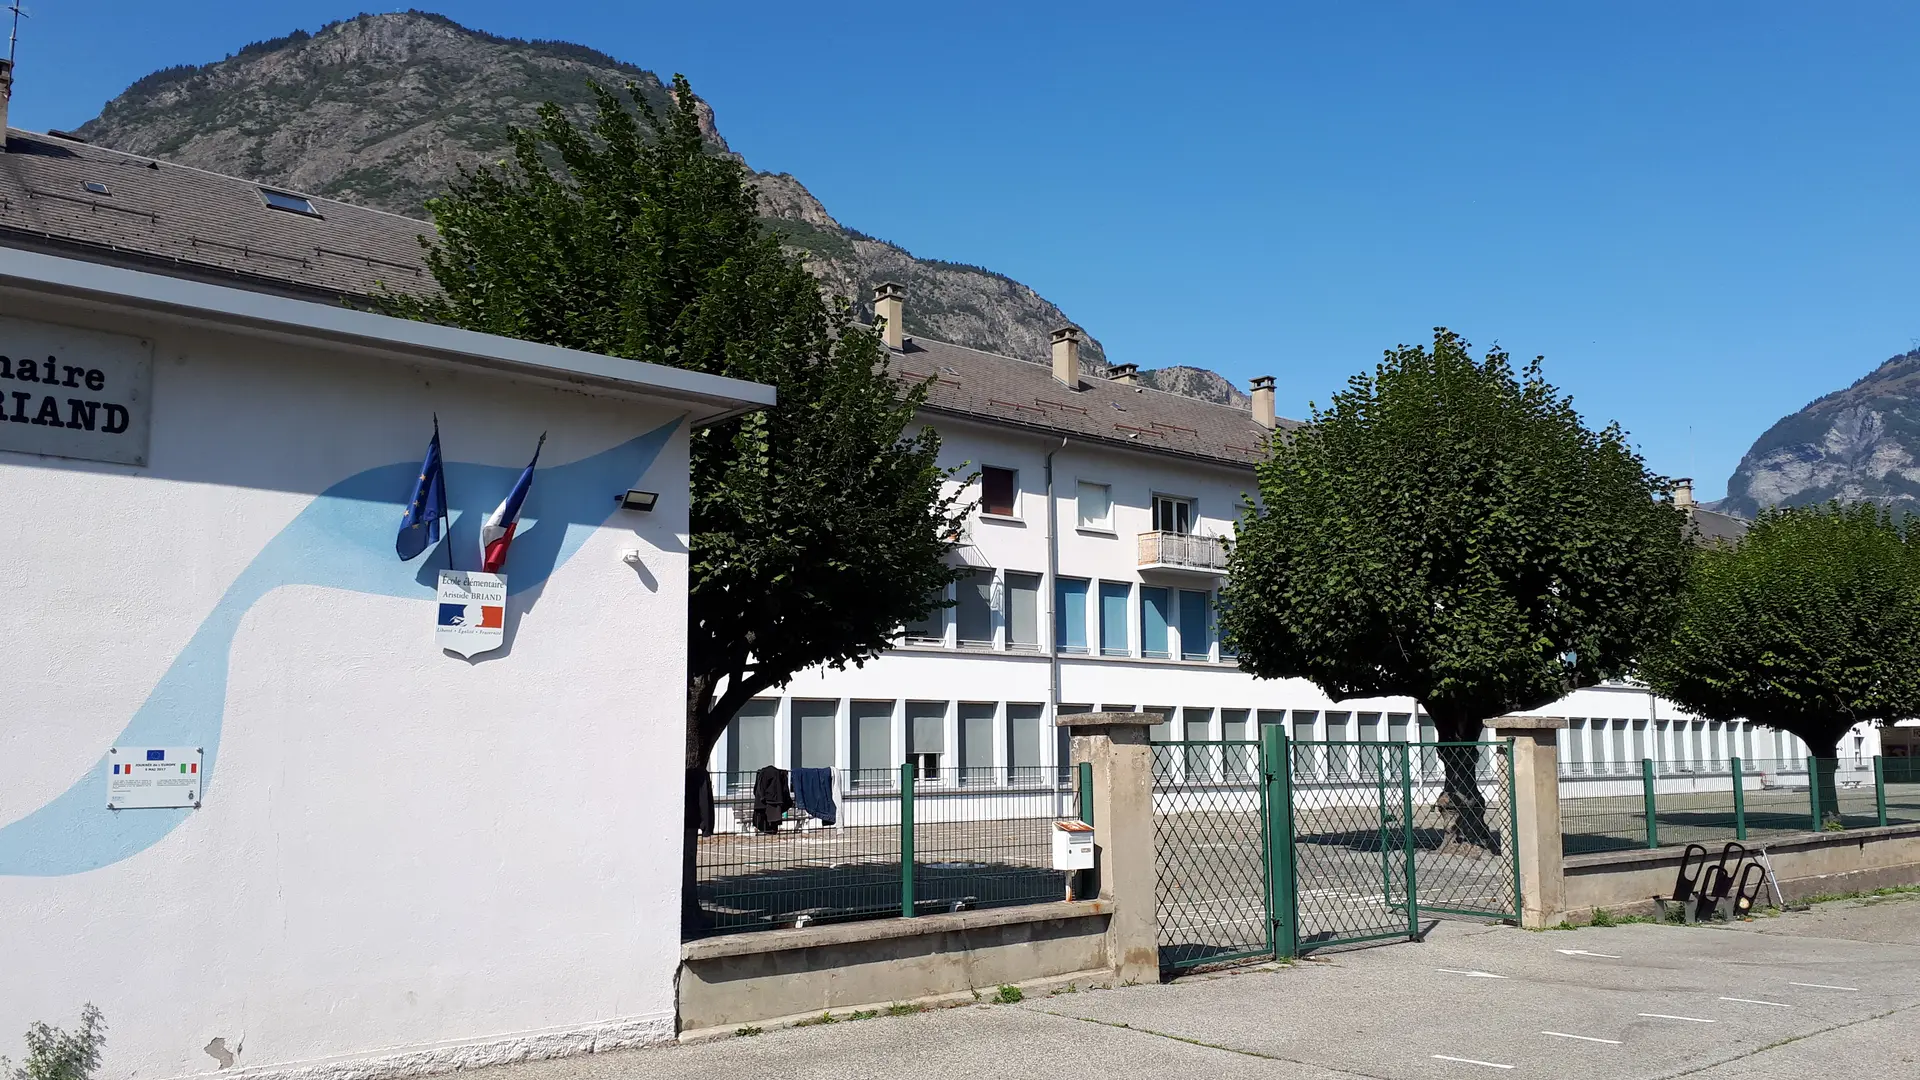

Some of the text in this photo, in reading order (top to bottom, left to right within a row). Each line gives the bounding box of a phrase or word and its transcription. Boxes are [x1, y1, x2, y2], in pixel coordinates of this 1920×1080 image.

[442, 573, 504, 589] École élémentaire
[443, 591, 502, 602] Aristide BRIAND
